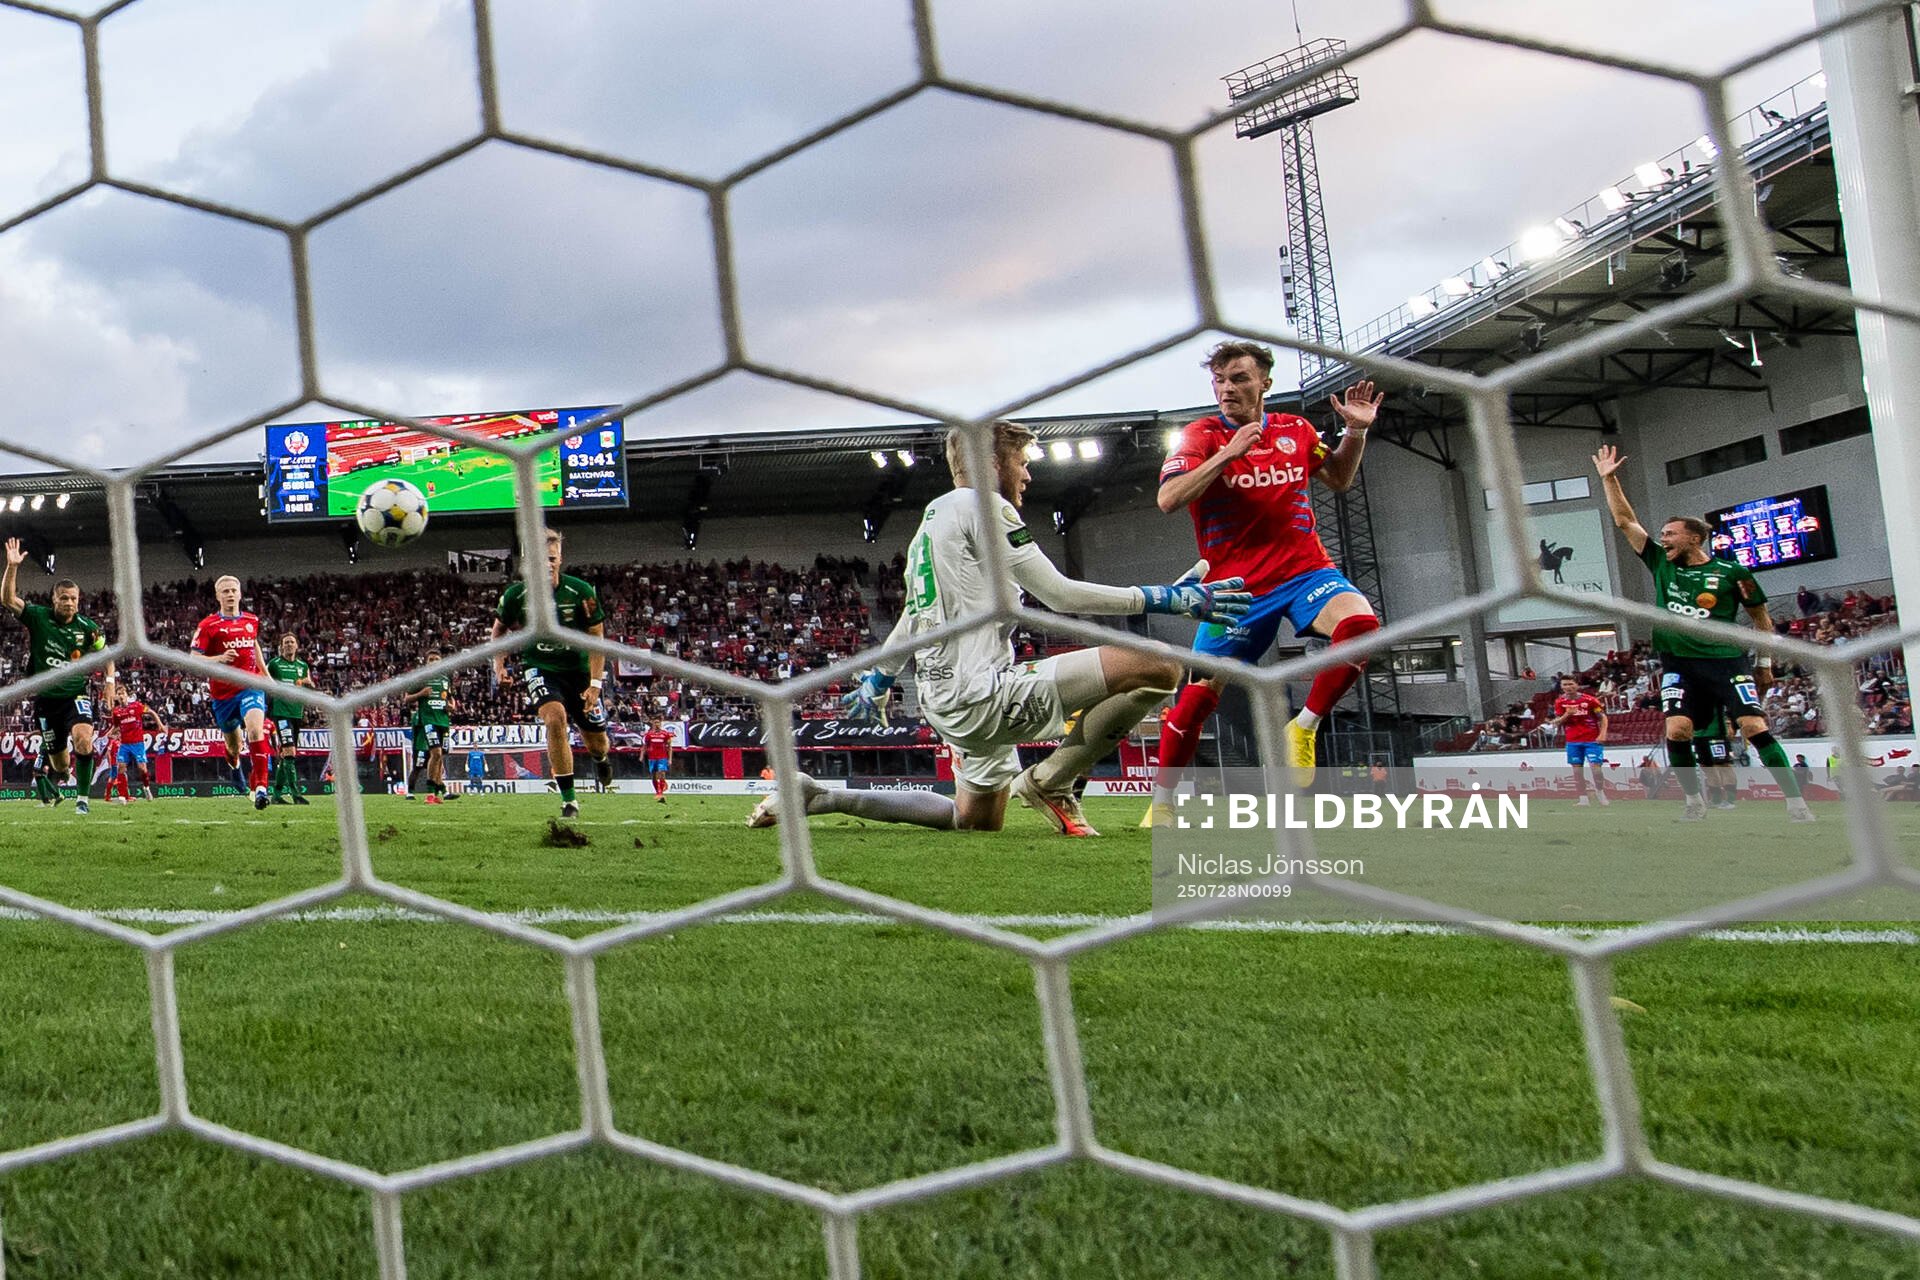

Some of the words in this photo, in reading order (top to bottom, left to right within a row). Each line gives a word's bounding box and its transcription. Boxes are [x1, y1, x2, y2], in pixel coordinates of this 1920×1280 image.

[568, 416, 577, 428] 1
[568, 452, 615, 467] 83:41
[1222, 463, 1304, 489] vobbiz
[1667, 601, 1711, 619] coop
[689, 720, 741, 741] Vila
[158, 786, 185, 796] akea
[670, 783, 713, 792] AllOffice
